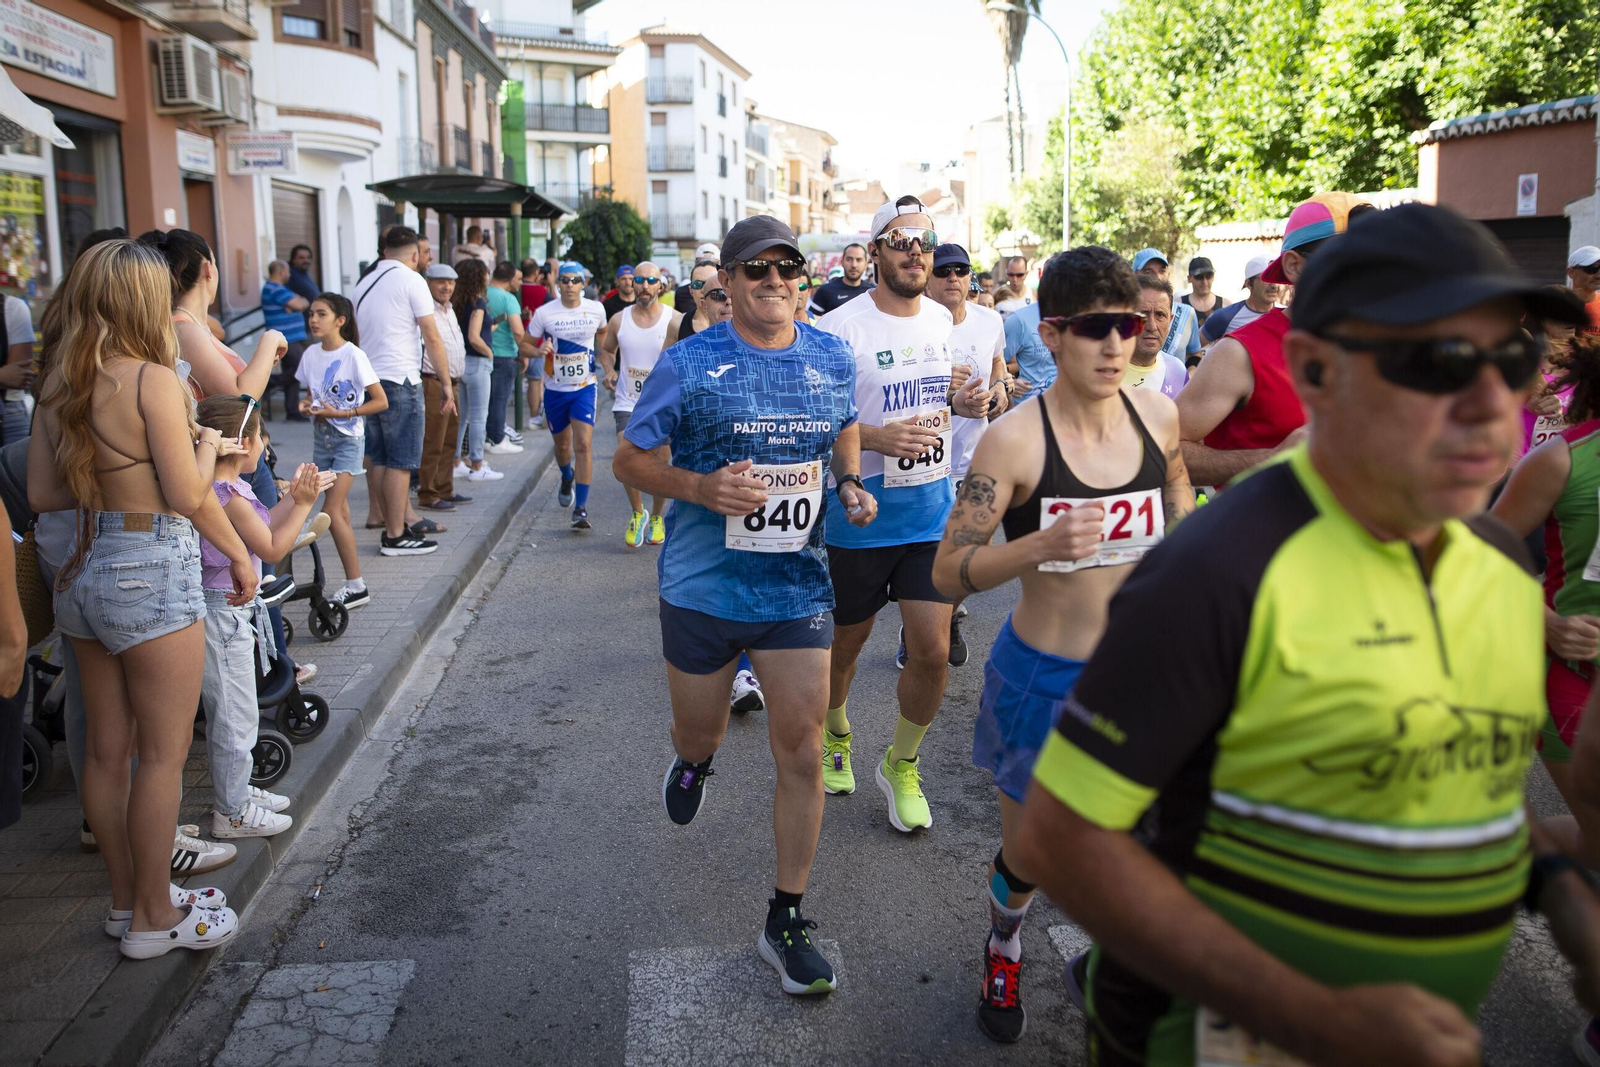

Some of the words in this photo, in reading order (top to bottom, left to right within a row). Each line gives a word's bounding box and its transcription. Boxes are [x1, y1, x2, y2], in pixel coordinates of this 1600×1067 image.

[559, 364, 584, 377] 195
[632, 369, 650, 377] FOND
[931, 395, 947, 404] FON
[733, 422, 777, 434] PAZITO
[779, 424, 786, 432] a
[789, 421, 831, 433] PAZITO
[768, 436, 796, 445] Motril
[743, 497, 811, 532] 840
[1048, 496, 1154, 542] 21
